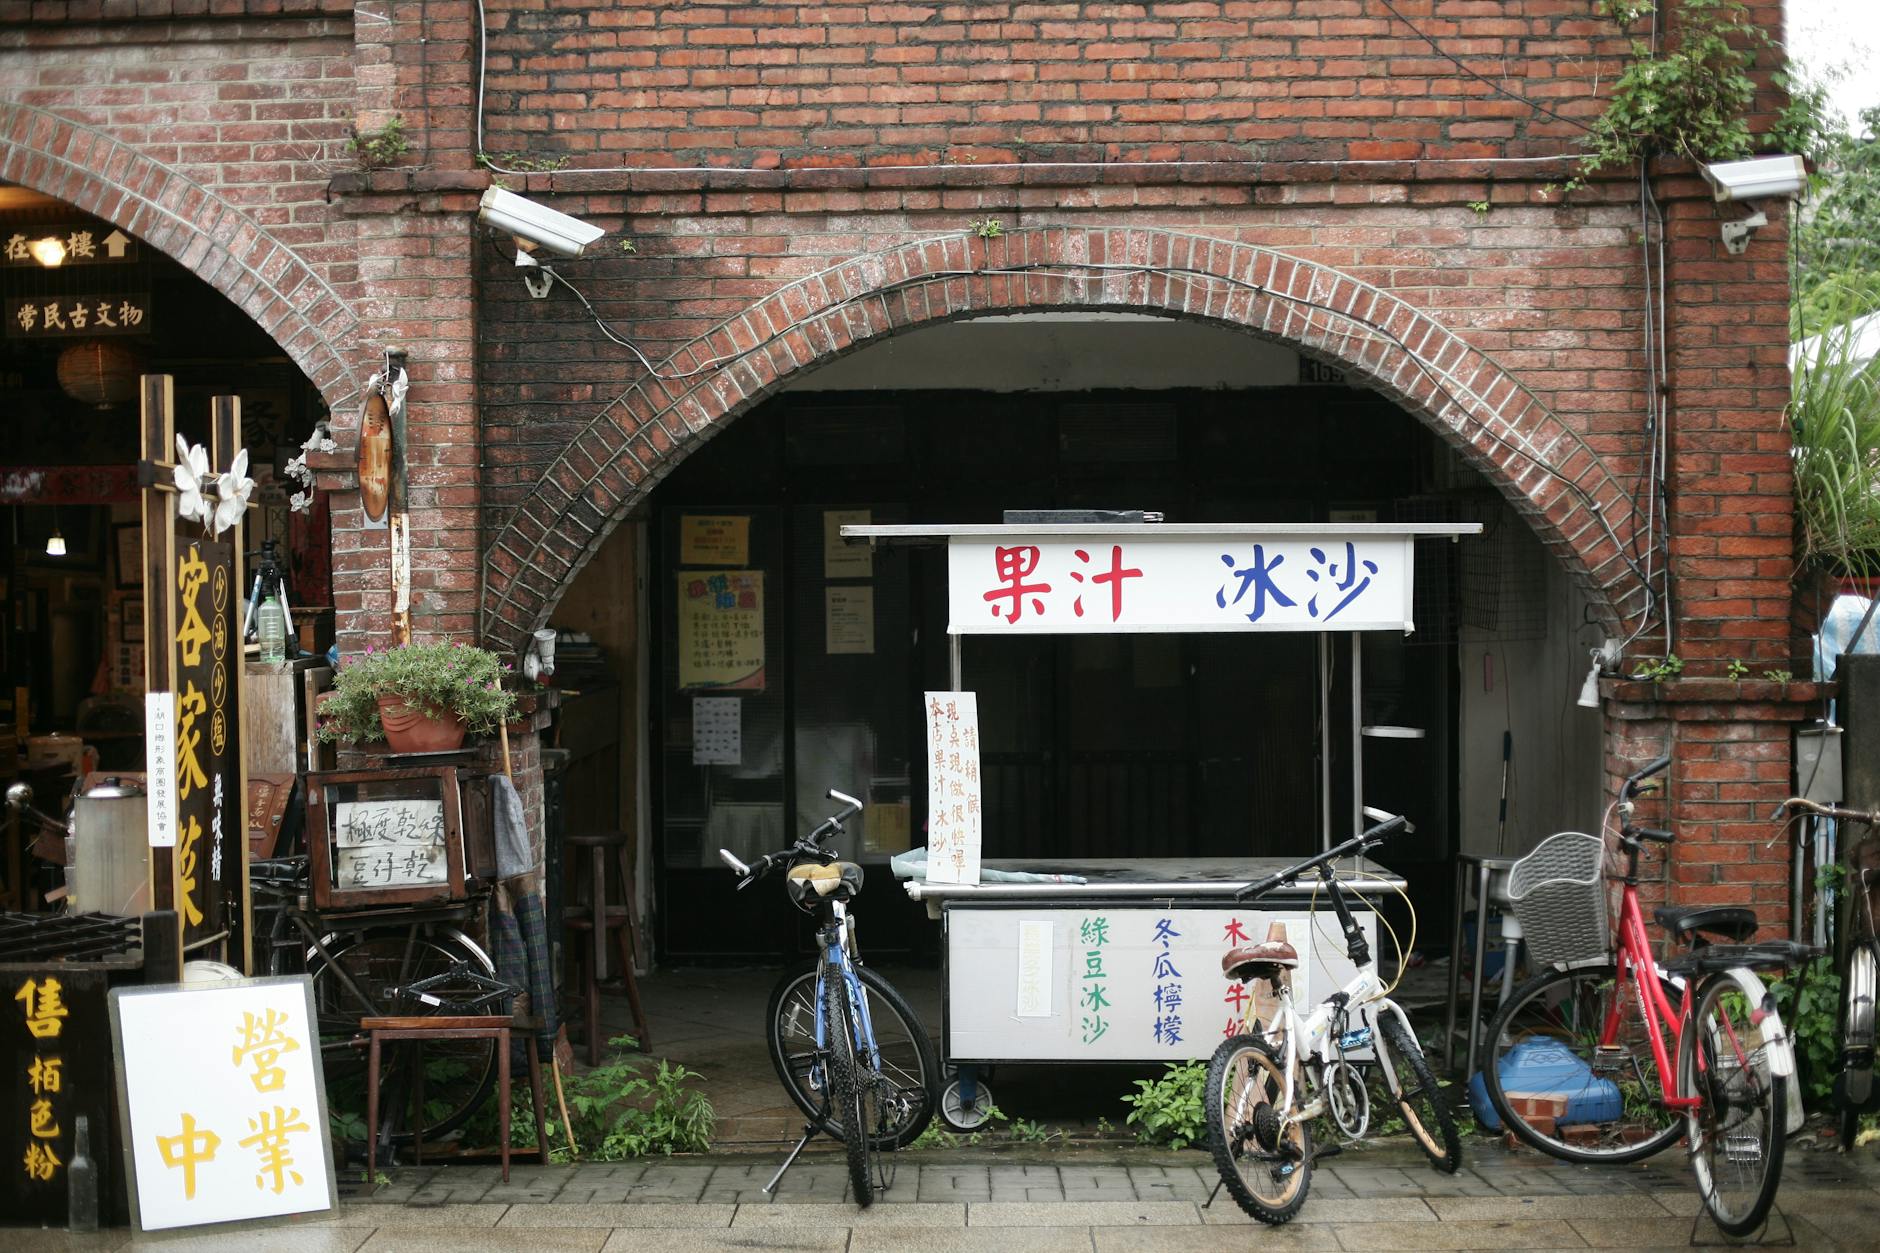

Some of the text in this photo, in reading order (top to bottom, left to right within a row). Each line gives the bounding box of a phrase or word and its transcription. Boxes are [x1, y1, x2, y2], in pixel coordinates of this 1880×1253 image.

[4, 230, 97, 262] 在樓
[17, 300, 143, 332] 常民古文物
[983, 542, 1378, 624] 果汁 冰沙
[211, 773, 224, 880] 無味精
[1080, 917, 1112, 1044] 綠豆冰沙
[1152, 918, 1184, 1046] 冬瓜檸檬
